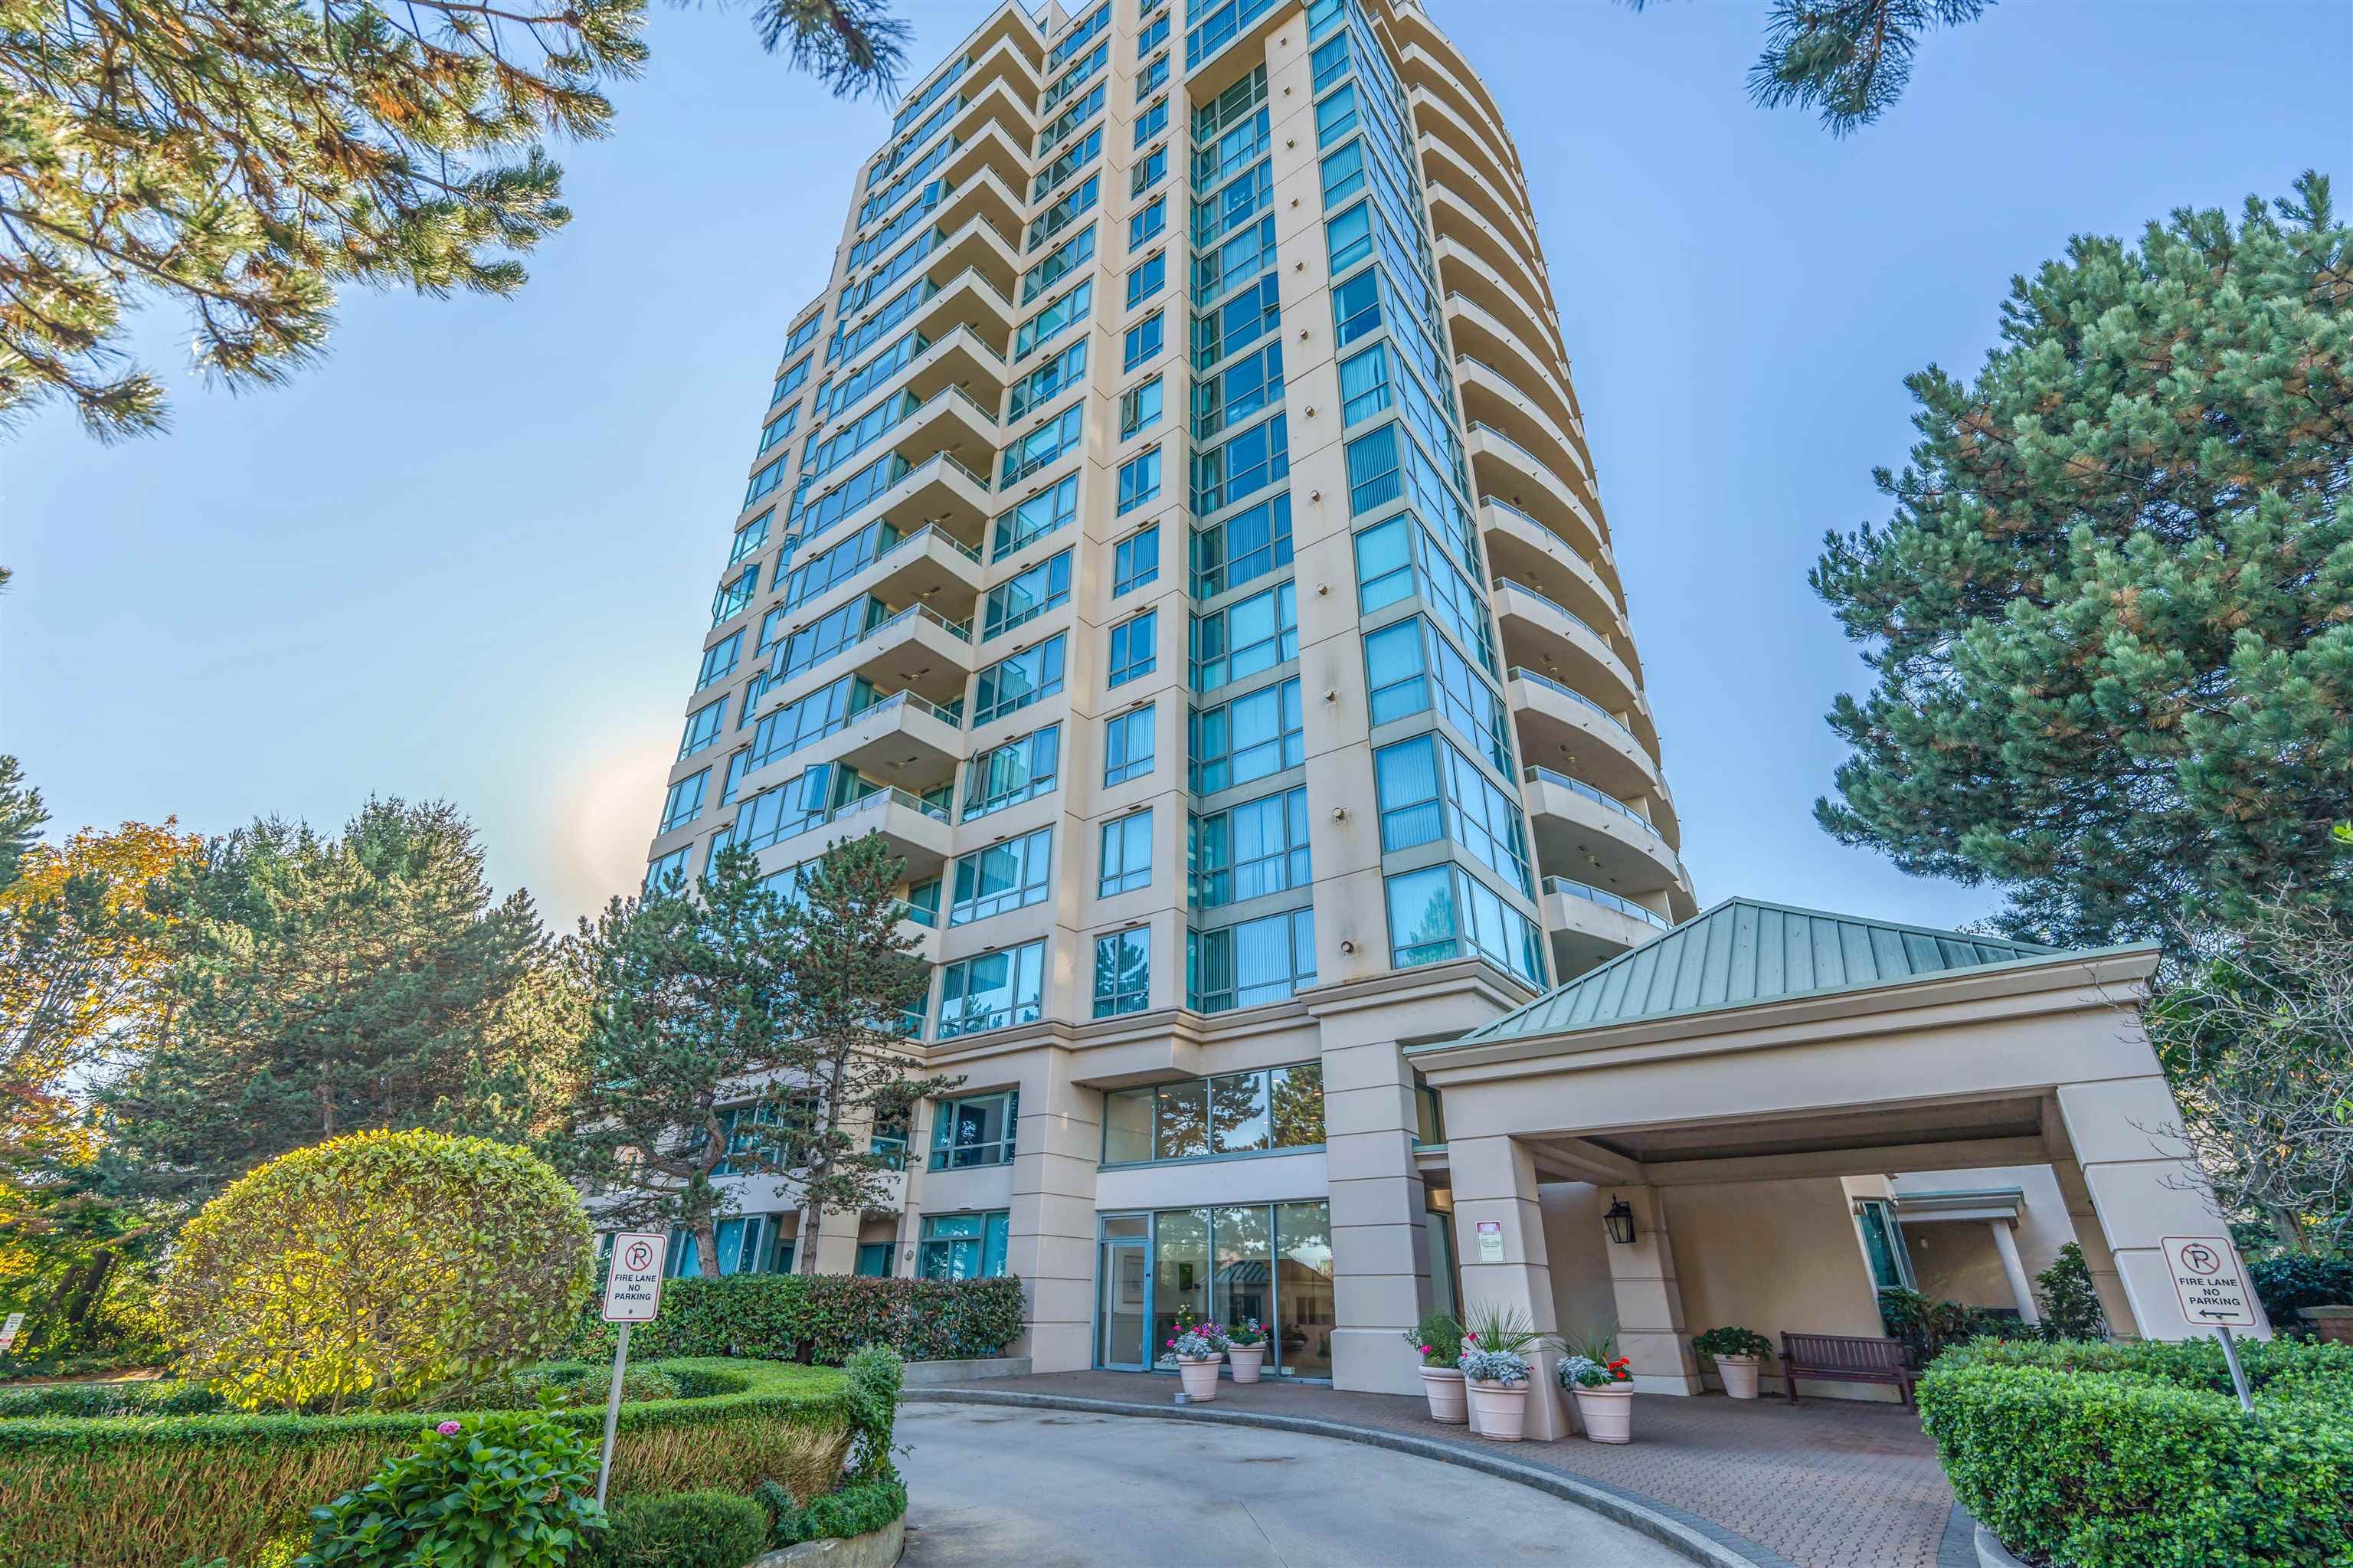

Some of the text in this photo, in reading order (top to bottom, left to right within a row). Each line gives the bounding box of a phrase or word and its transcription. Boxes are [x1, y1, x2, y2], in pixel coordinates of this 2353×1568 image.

[2179, 1278, 2238, 1287] FIRE LANE
[2189, 1297, 2241, 1306] PARKING
